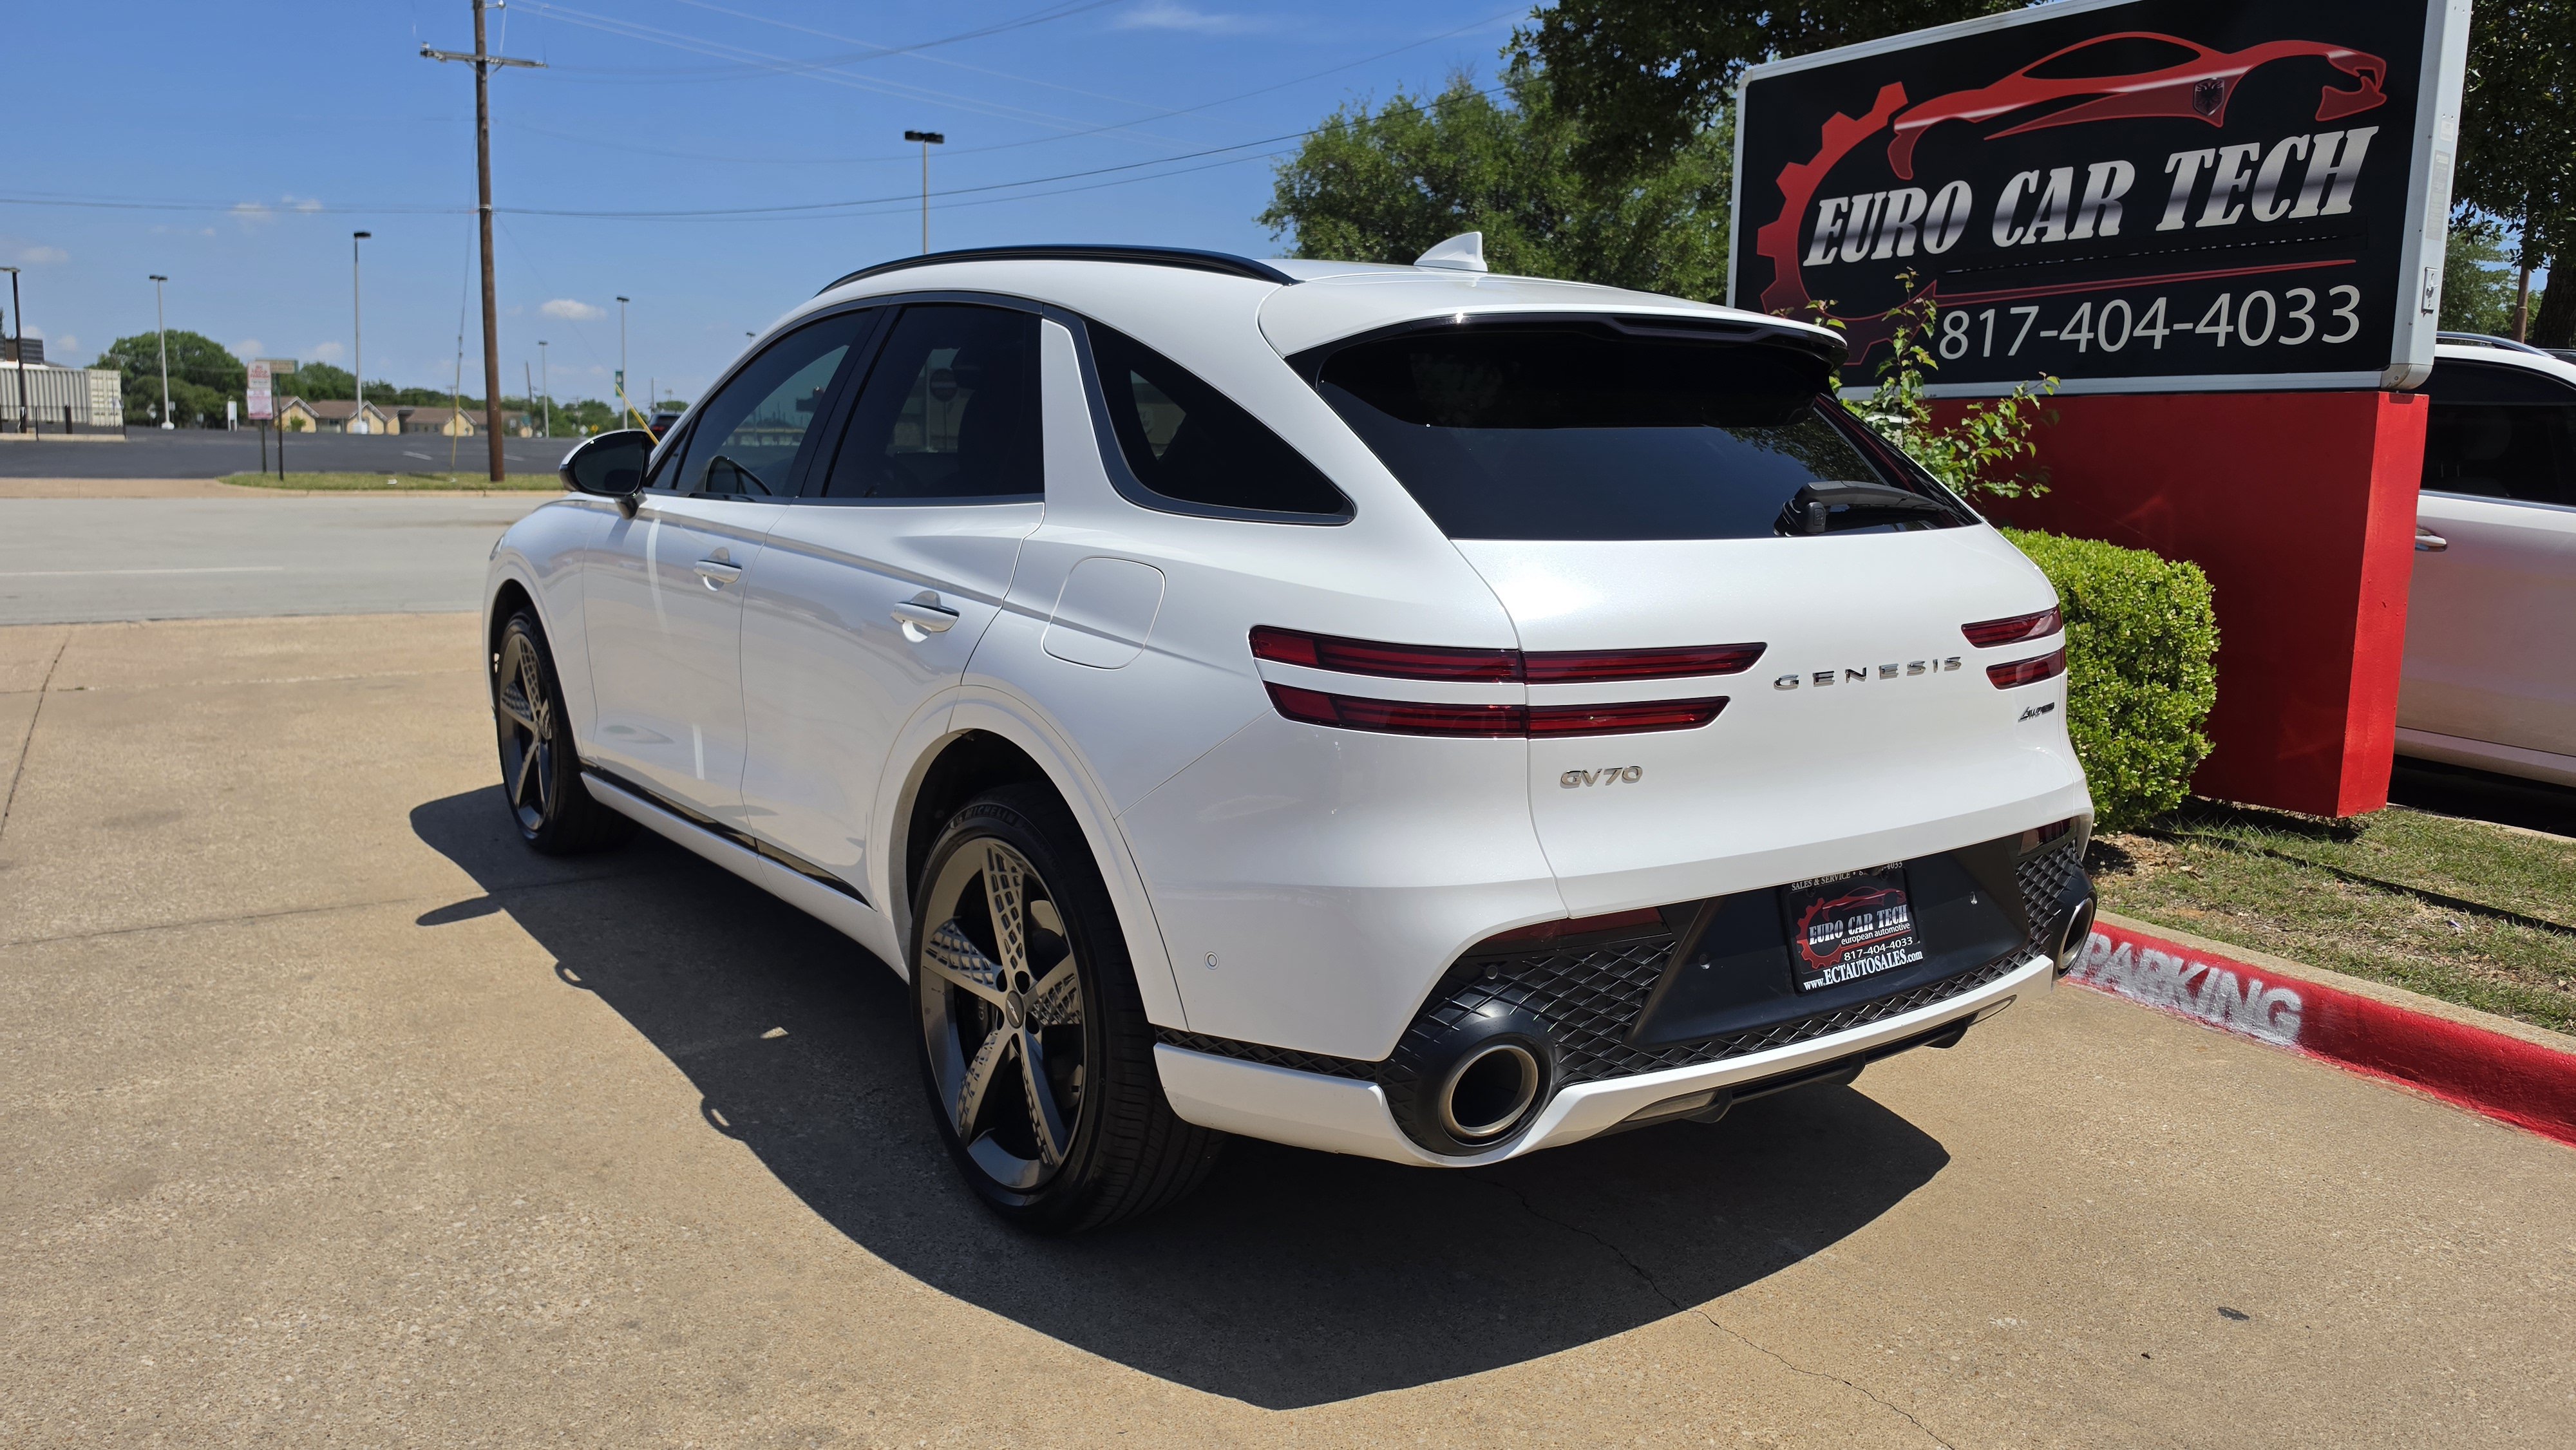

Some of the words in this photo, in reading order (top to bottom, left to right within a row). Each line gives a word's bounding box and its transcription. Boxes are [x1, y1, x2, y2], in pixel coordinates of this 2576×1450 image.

[1803, 179, 1972, 266] EURO
[1991, 158, 2135, 248] CAR
[2155, 126, 2380, 232] TECH
[1938, 284, 2362, 360] 817-404-4033
[1774, 656, 1962, 691] GENESIS
[1560, 766, 1643, 789] GV70
[964, 806, 1015, 824] MICHELIN
[1792, 880, 1812, 891] SALES
[1814, 878, 1820, 886] &
[1821, 871, 1851, 885] SERVICE
[1809, 919, 1844, 945] EURO
[1848, 912, 1873, 935] CAR
[1877, 904, 1908, 928] TECH
[1841, 931, 1873, 946] european
[1874, 923, 1911, 937] automotive
[1844, 936, 1913, 961] 817-404-4033
[1803, 948, 1924, 991] www.ECTAUTOSALES.com
[2069, 932, 2303, 1046] PARKING
